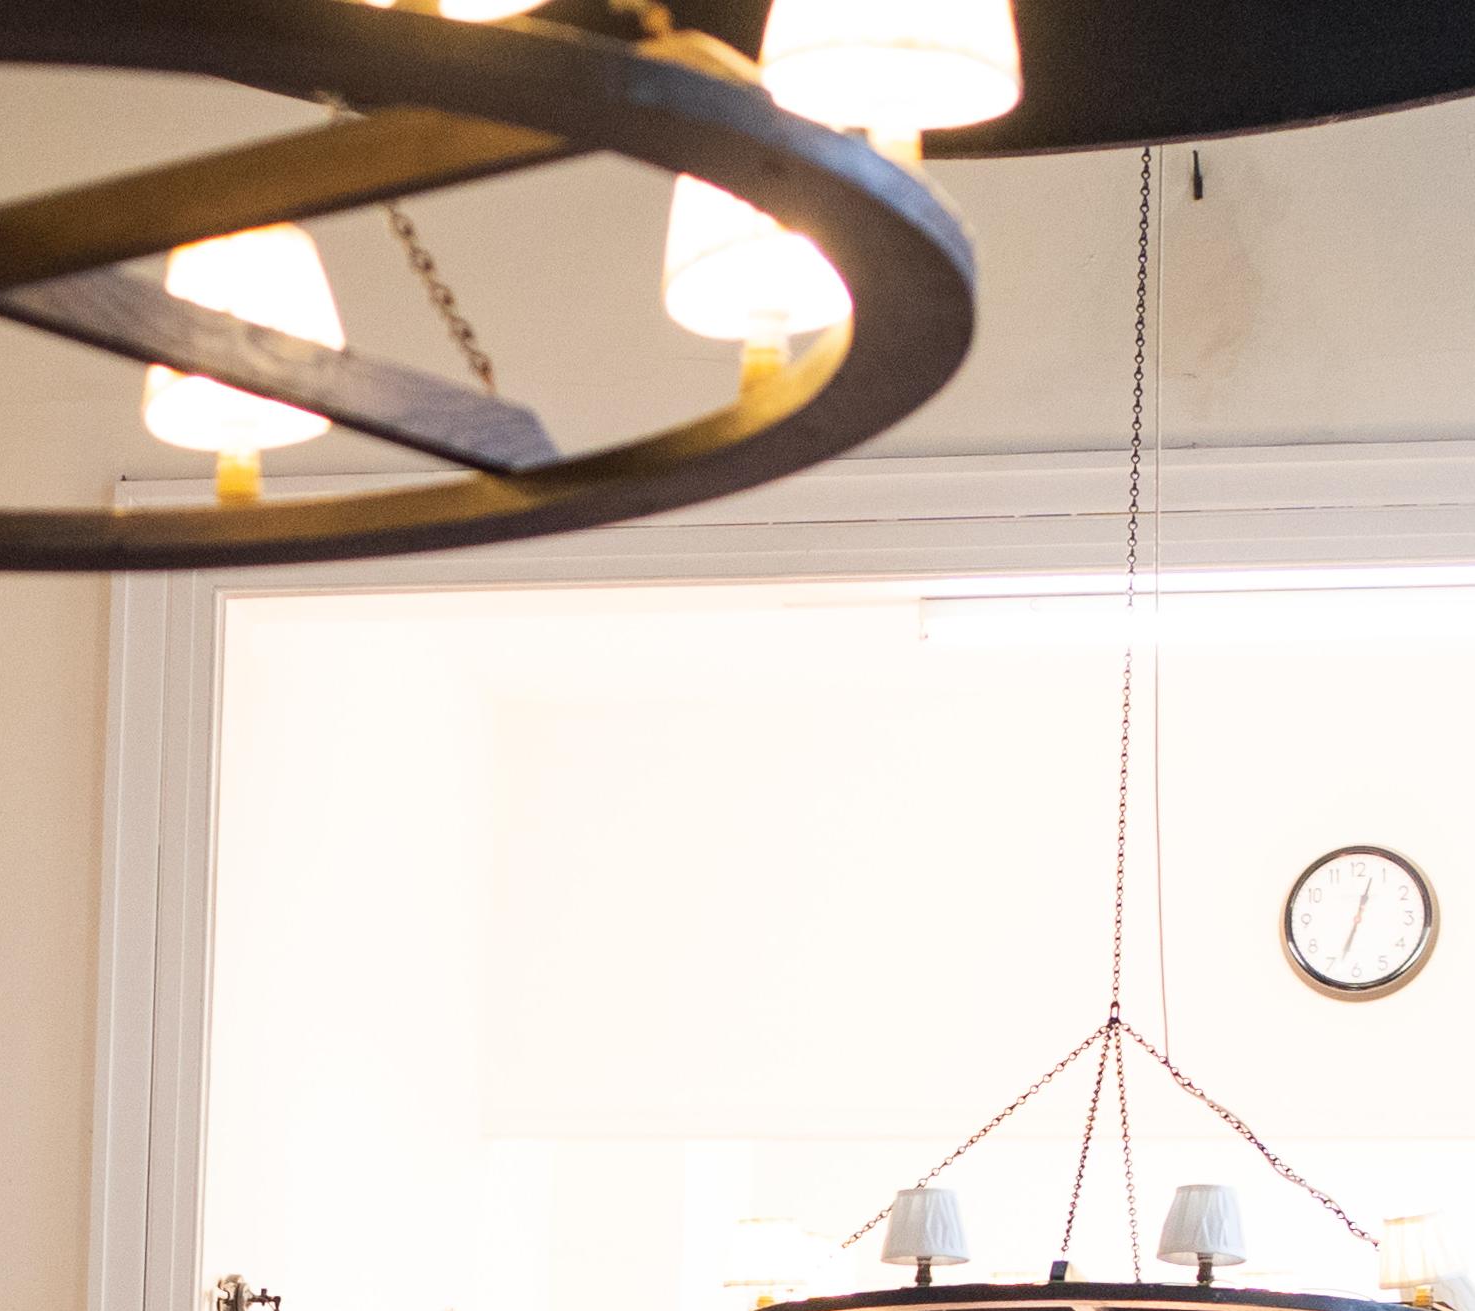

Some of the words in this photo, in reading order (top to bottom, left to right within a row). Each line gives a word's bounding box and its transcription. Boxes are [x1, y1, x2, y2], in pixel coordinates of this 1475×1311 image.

[1350, 862, 1366, 878] 12
[1308, 888, 1322, 904] 10
[1398, 885, 1409, 901] 2
[1403, 911, 1415, 926] 3
